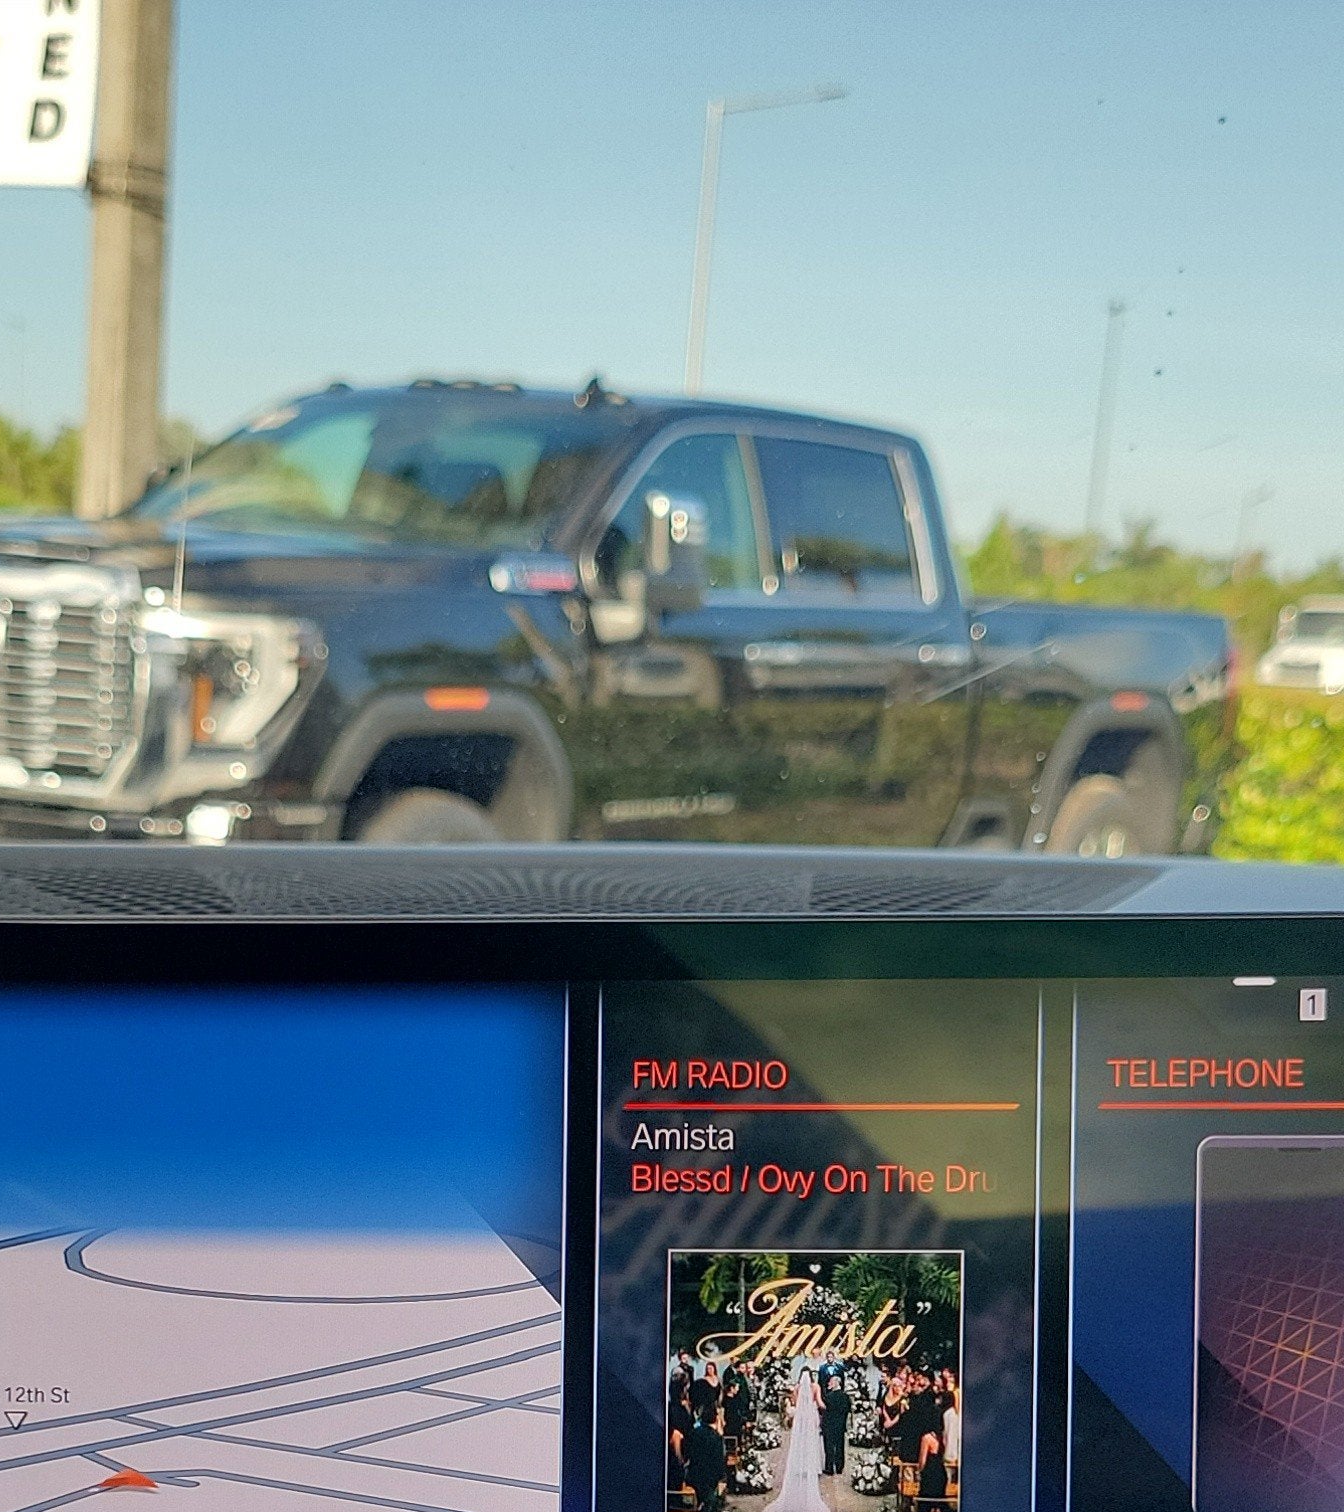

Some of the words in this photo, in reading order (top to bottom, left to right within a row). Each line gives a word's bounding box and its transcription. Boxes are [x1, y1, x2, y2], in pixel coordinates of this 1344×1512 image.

[632, 1060, 678, 1090] FM
[687, 1060, 789, 1090] RADIO
[1106, 1057, 1305, 1089] TELEPHONE
[630, 1122, 735, 1152] Amista
[631, 1164, 733, 1194] Blessd
[758, 1164, 816, 1199] Ovy
[823, 1164, 868, 1194] On
[876, 1164, 935, 1194] The
[4, 1386, 46, 1404] 12th
[50, 1386, 71, 1405] St
